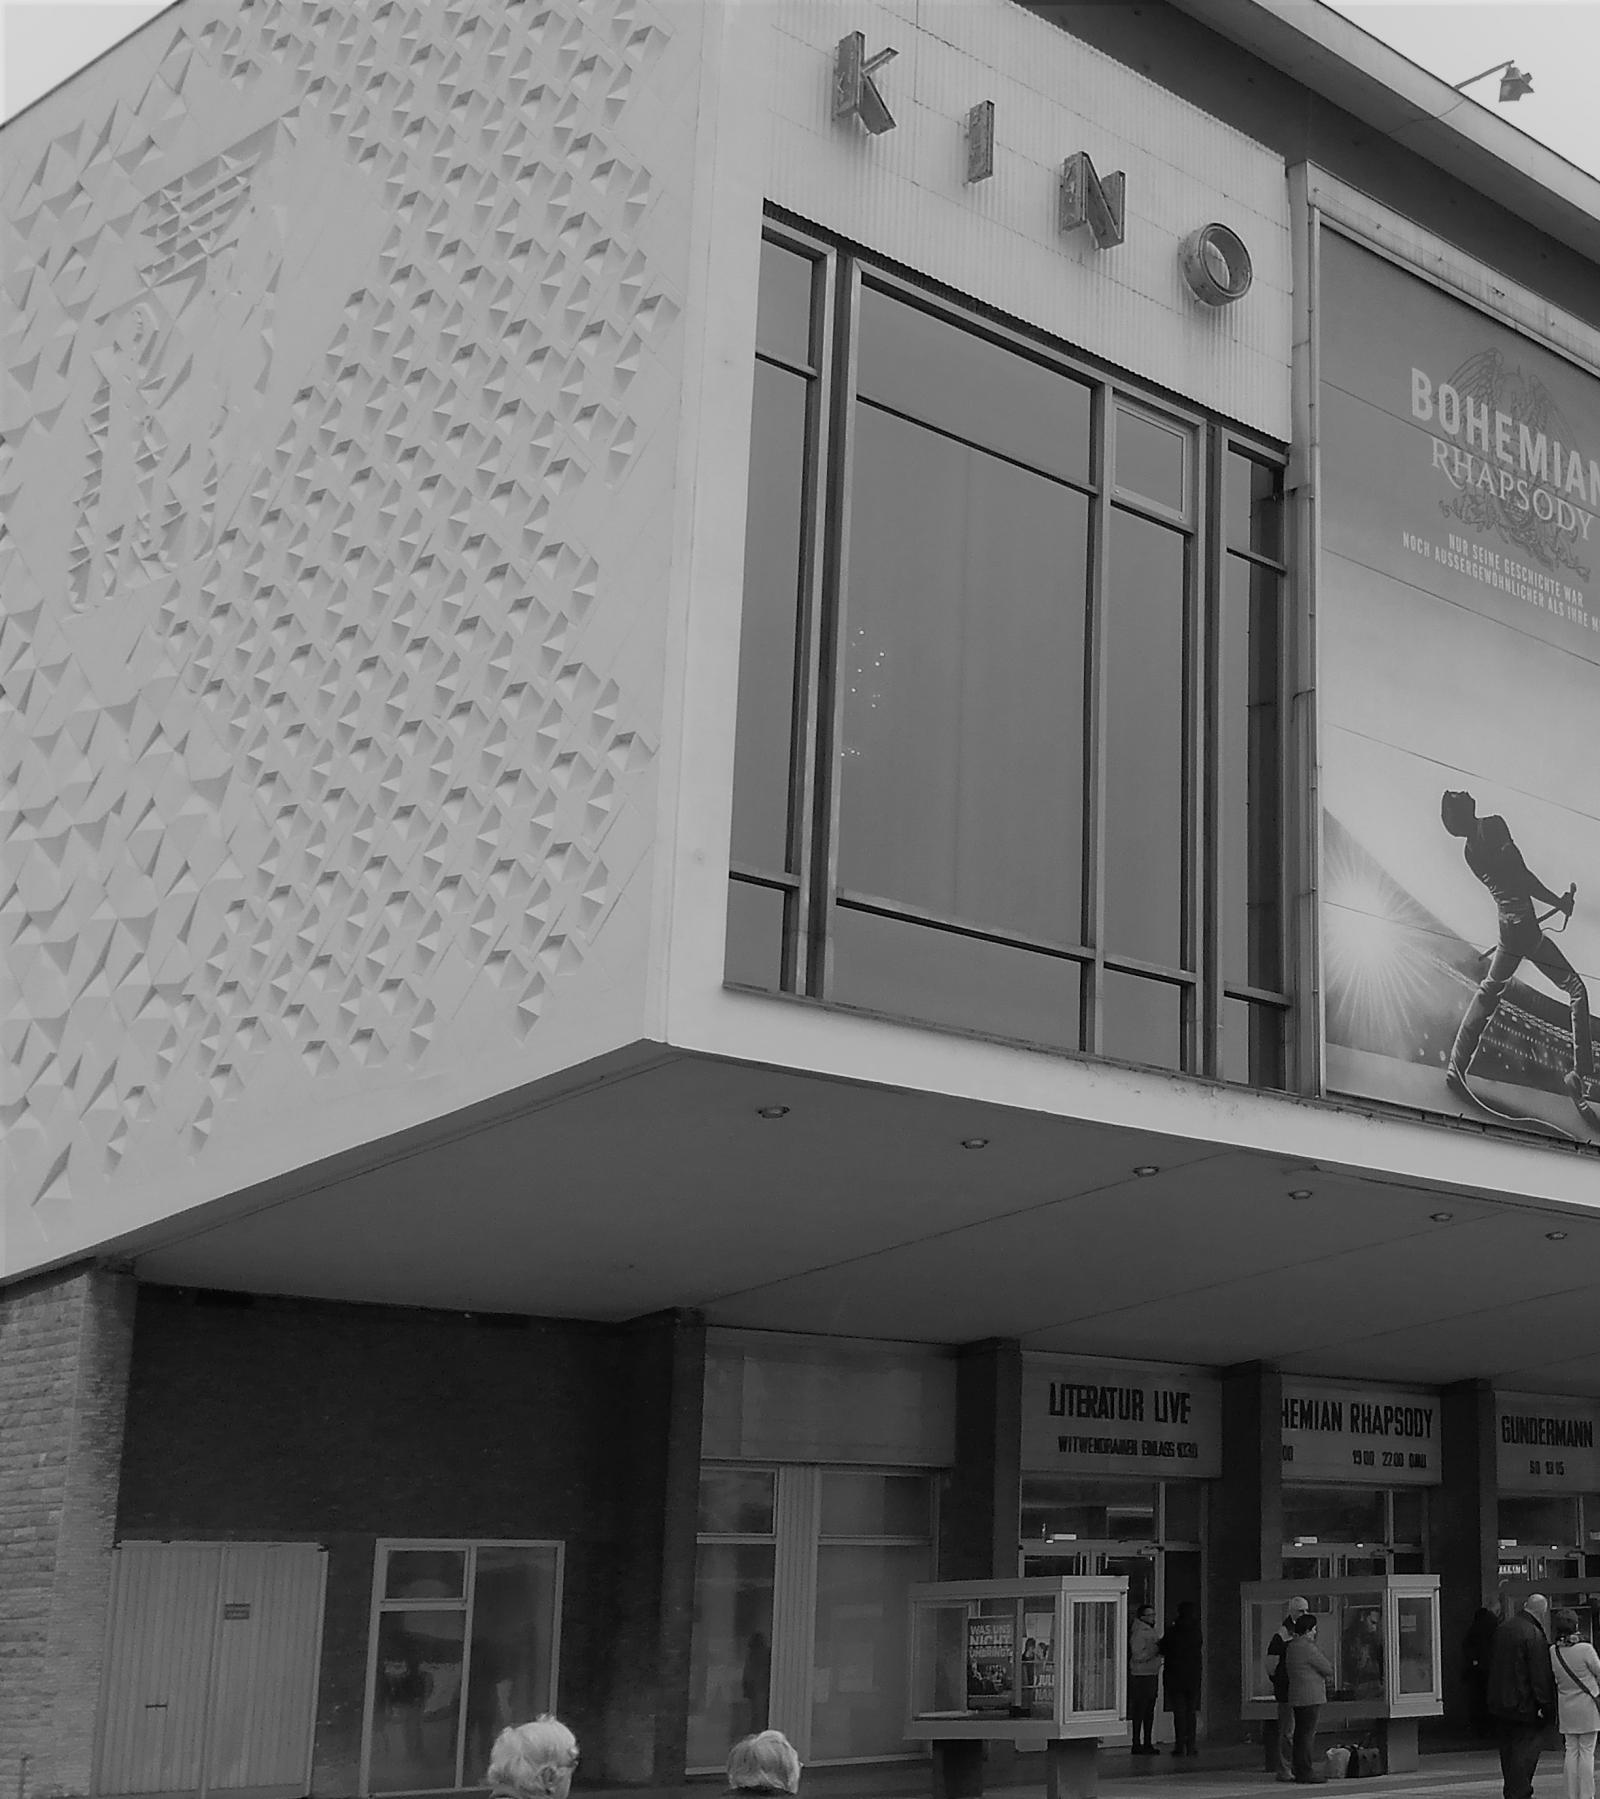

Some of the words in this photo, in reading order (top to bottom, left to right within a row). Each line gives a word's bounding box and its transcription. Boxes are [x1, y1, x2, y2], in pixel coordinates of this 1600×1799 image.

[833, 31, 1253, 306] KINO
[1431, 437, 1595, 540] RHAPSODY
[1402, 531, 1430, 558] NOCH
[1547, 597, 1565, 617] ALS
[1567, 606, 1589, 628] IHRE
[1448, 533, 1469, 557] NUR
[1472, 544, 1500, 571] SEINE
[1504, 558, 1561, 598] GESCHICHTE
[1563, 585, 1585, 608] WAR
[1049, 1382, 1144, 1421] LITERATUR
[1153, 1390, 1191, 1424] LIVE
[1350, 1402, 1433, 1439] RHAPSODY
[1501, 1415, 1594, 1448] GUNDERMANN
[969, 1624, 991, 1635] WAS
